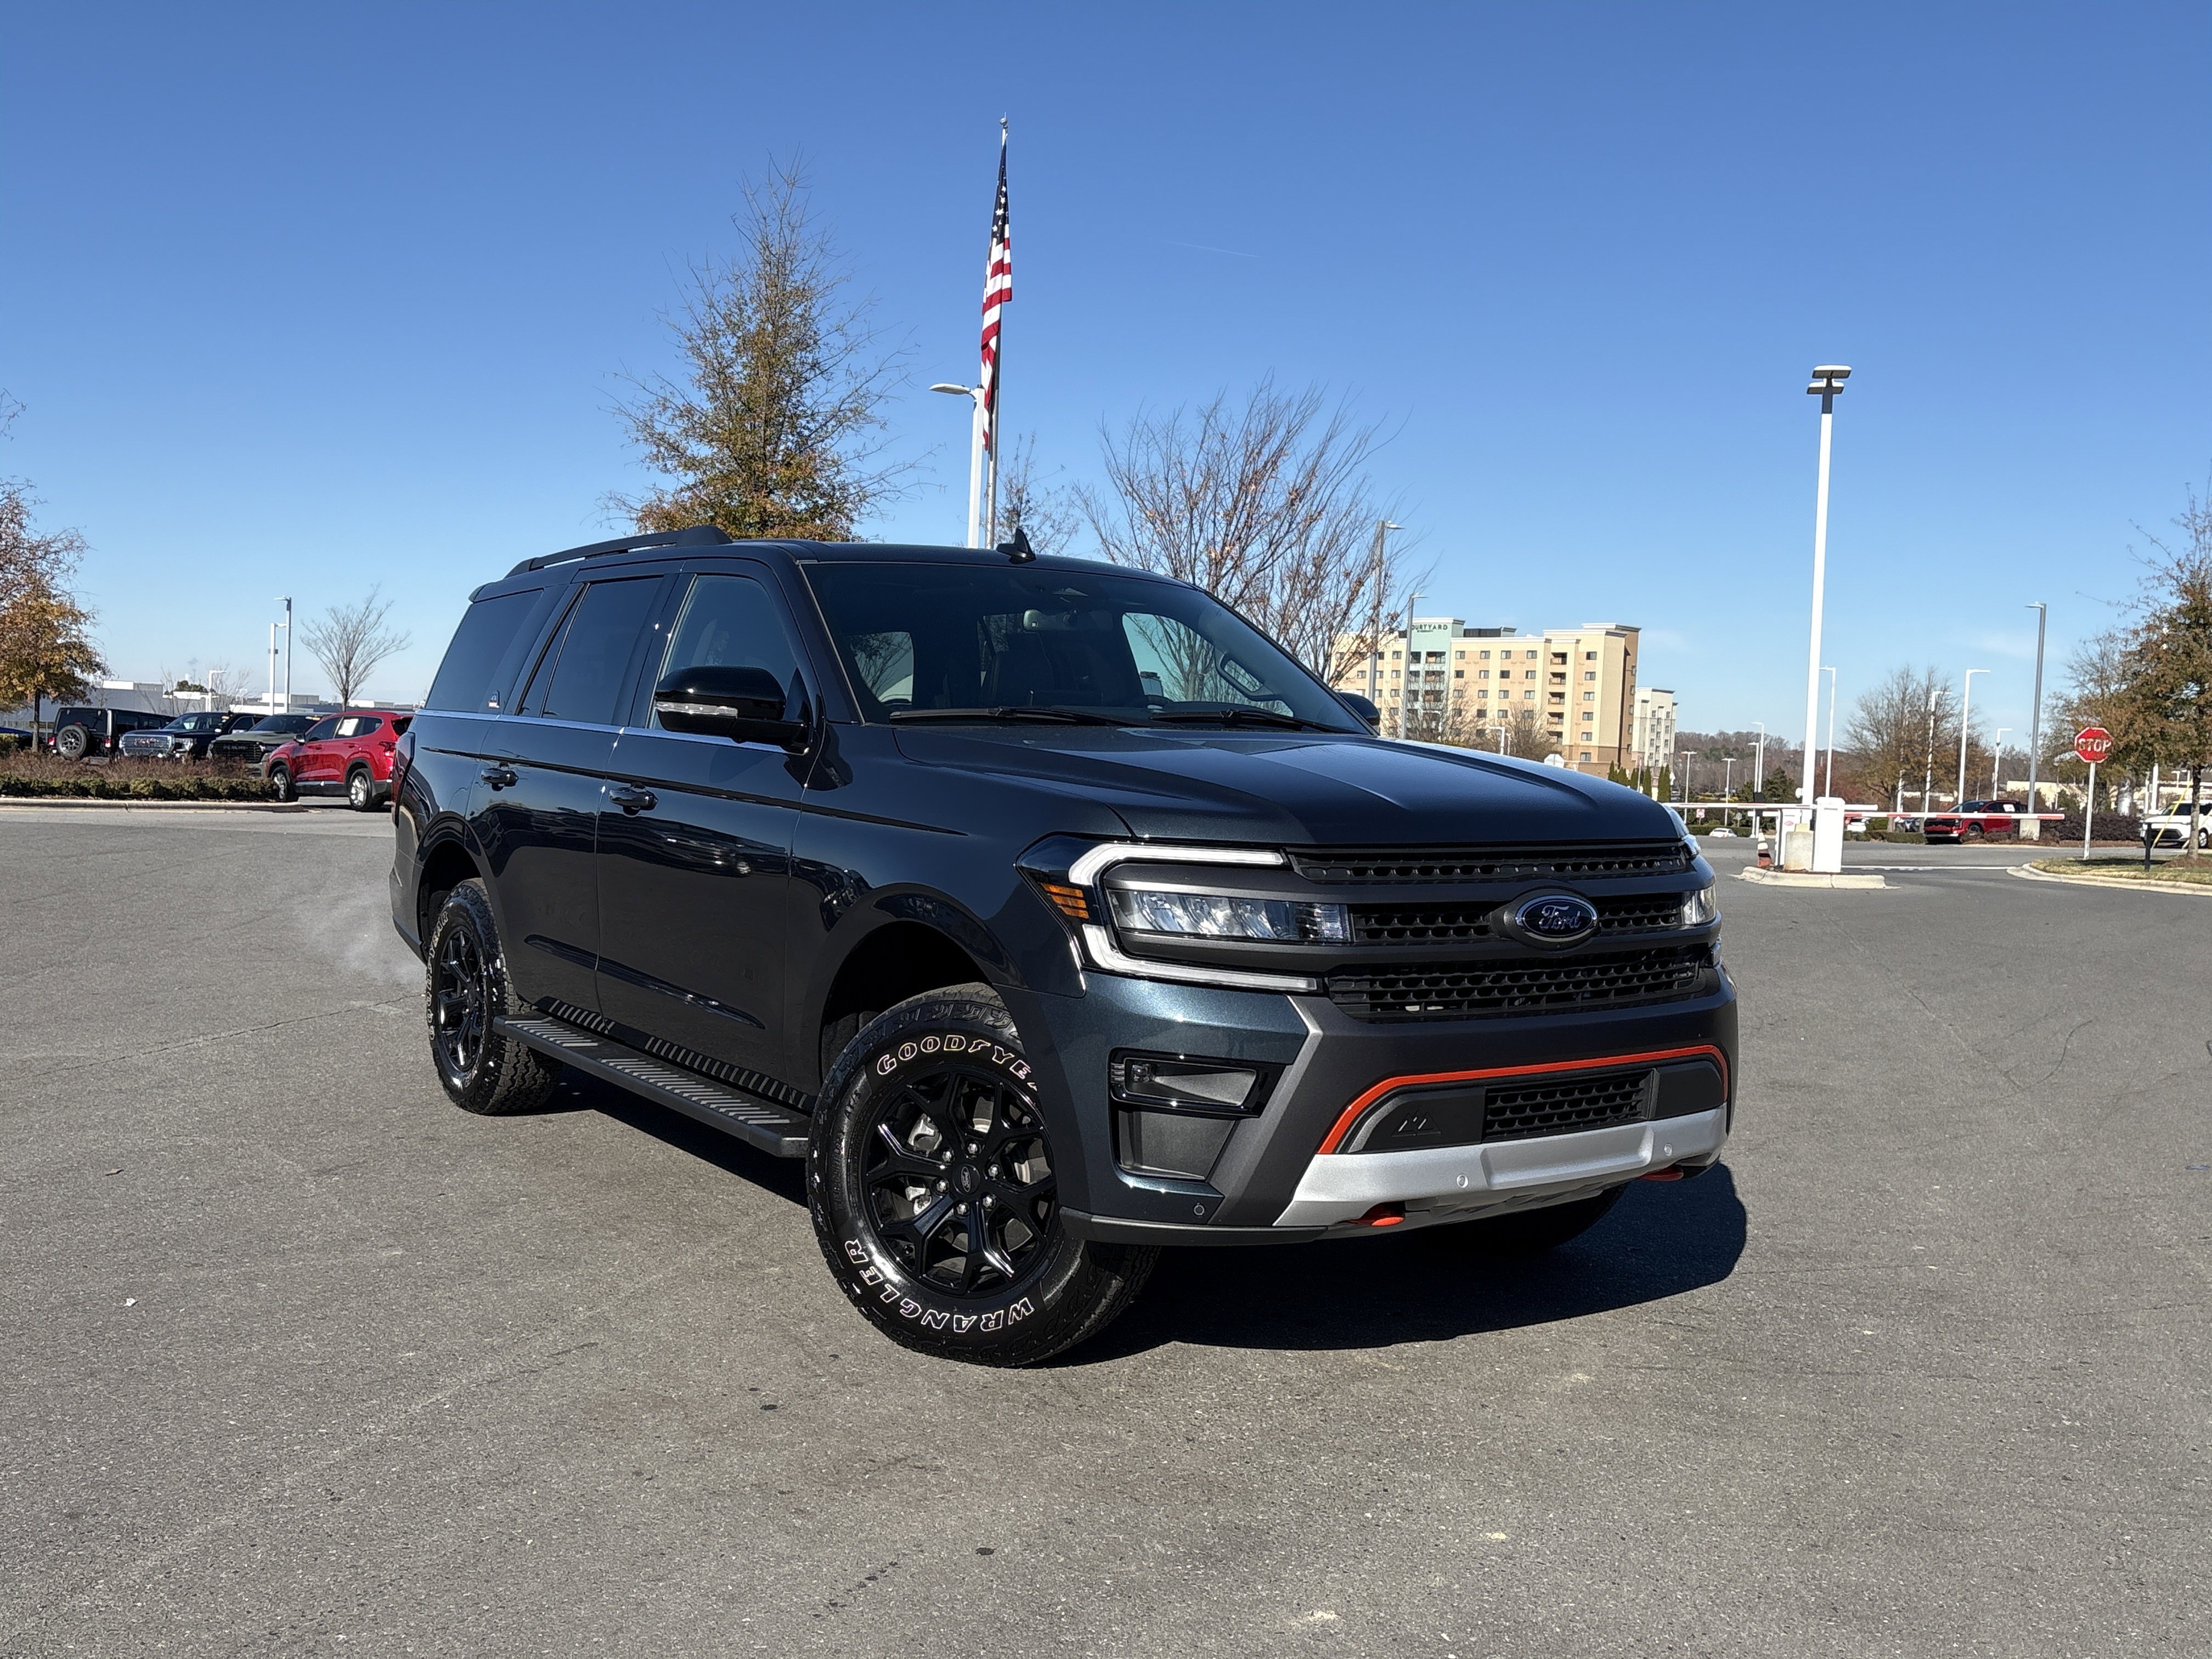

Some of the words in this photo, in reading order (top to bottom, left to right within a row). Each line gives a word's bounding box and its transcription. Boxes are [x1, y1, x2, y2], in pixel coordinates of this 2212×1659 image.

[2078, 738, 2112, 752] STOP
[1539, 905, 1582, 930] Ford
[877, 1035, 1038, 1092] GOODYE
[844, 1239, 1035, 1333] WRANGLER
